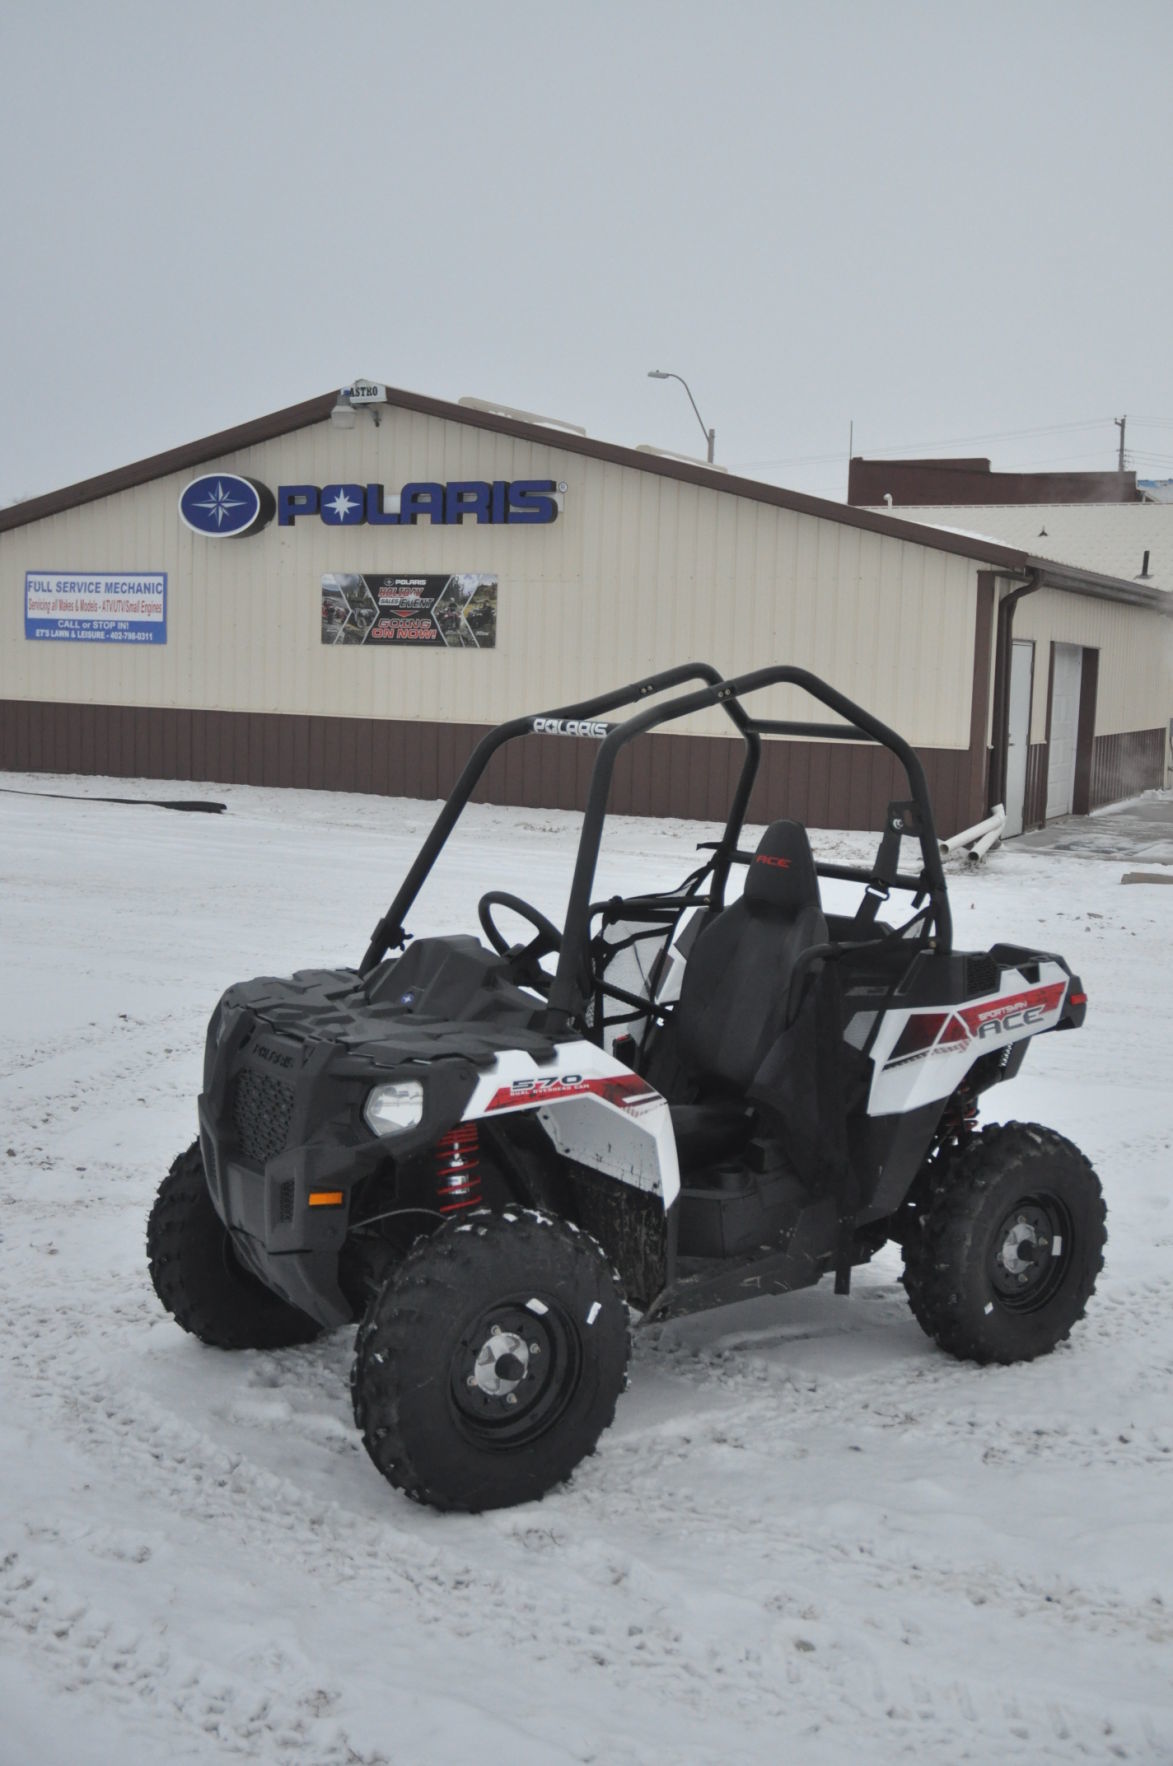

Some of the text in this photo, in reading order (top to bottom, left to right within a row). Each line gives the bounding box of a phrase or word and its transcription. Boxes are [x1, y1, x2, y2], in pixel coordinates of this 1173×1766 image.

[349, 385, 378, 397] ASTRO
[278, 480, 558, 526] POLARIS
[27, 580, 163, 594] FULL SERVICE MECHANIC
[28, 598, 51, 614] Servicing
[59, 600, 74, 612] Makes
[80, 600, 98, 612] Models
[141, 600, 162, 616] Engines
[399, 597, 434, 609] EVENT
[57, 620, 81, 629] CALL
[92, 621, 116, 630] STOP
[117, 621, 129, 630] IN!
[378, 618, 432, 629] GOING
[50, 629, 70, 638] LAWN
[77, 630, 106, 639] LEISURE
[371, 628, 395, 639] ON
[396, 628, 438, 640] NOW!
[533, 718, 608, 738] POLARIS
[756, 854, 792, 869] ACE
[977, 1001, 1028, 1022] SPORTSMAN
[978, 1006, 1045, 1039] ACE
[511, 1073, 583, 1091] 570
